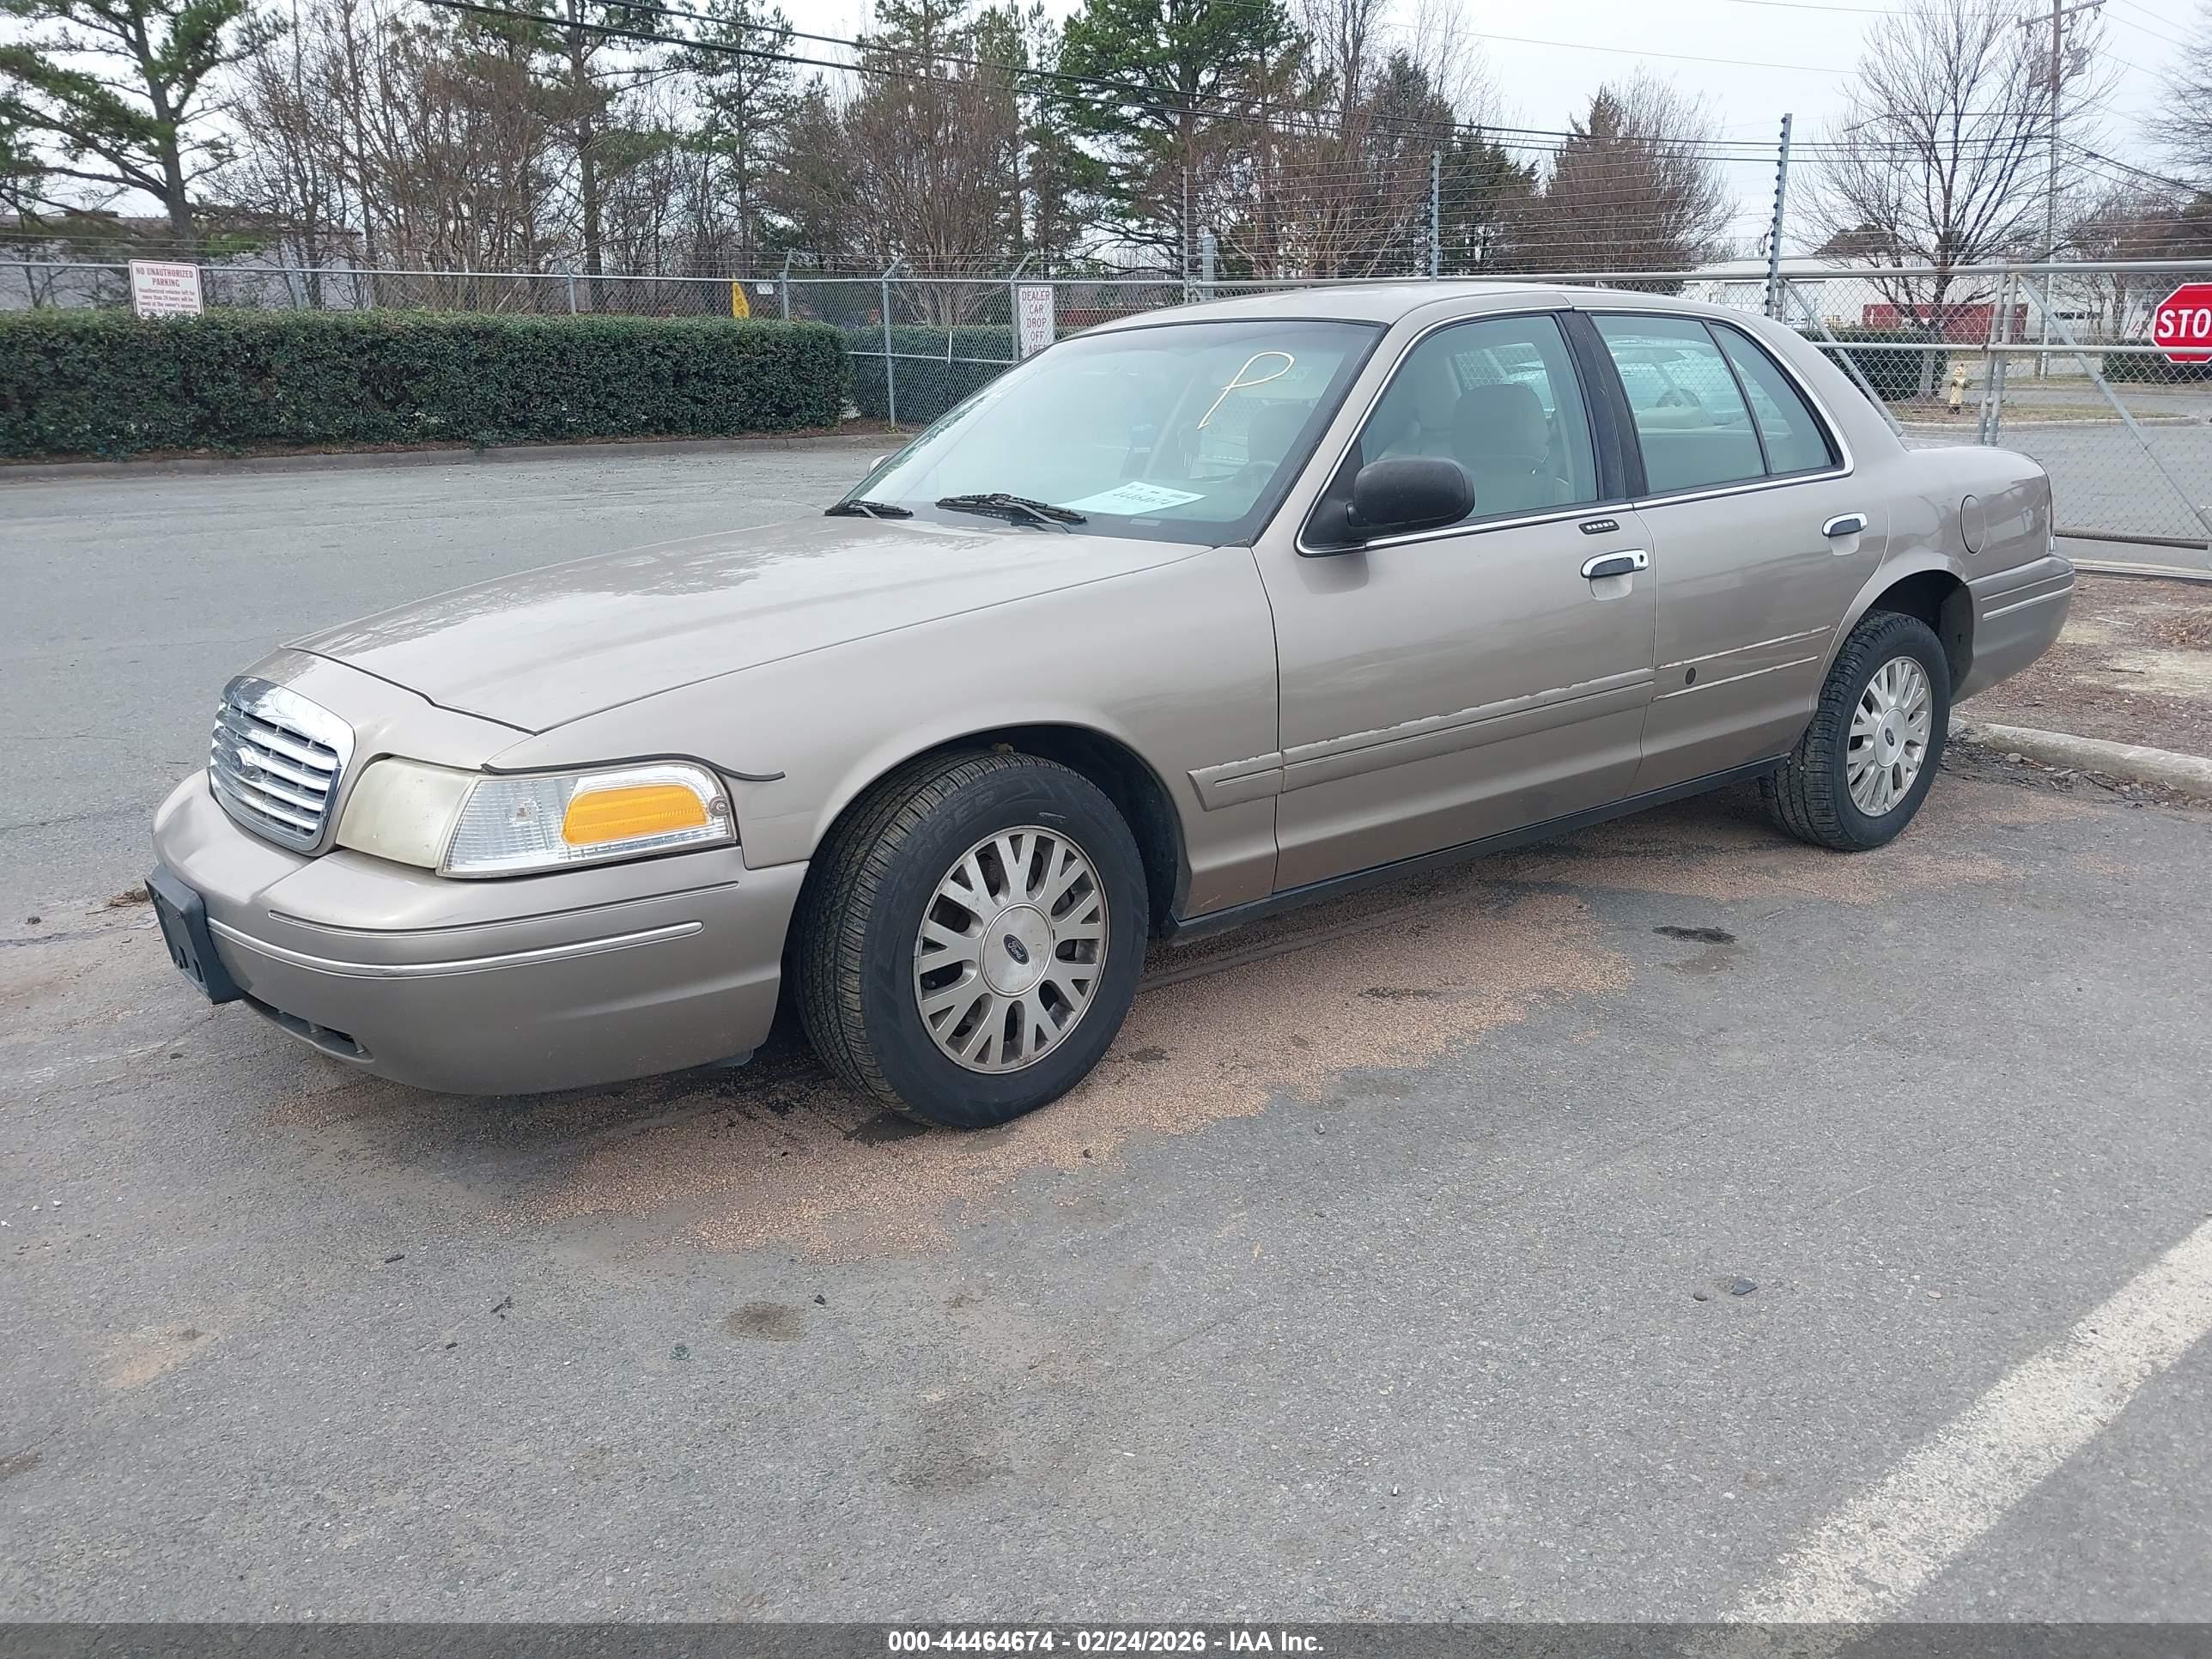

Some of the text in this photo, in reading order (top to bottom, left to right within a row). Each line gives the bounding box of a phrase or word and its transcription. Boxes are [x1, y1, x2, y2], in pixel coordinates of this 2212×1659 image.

[147, 268, 193, 278] UNAUTHORIZED
[152, 277, 180, 287] PARKING
[1022, 290, 1050, 301] DEALER
[1029, 304, 1044, 314] CAR
[1026, 317, 1047, 328] DROP
[2158, 308, 2211, 337] STO
[1030, 331, 1045, 342] OFF
[1029, 344, 1046, 354] ARE
[1006, 939, 1026, 961] Ford
